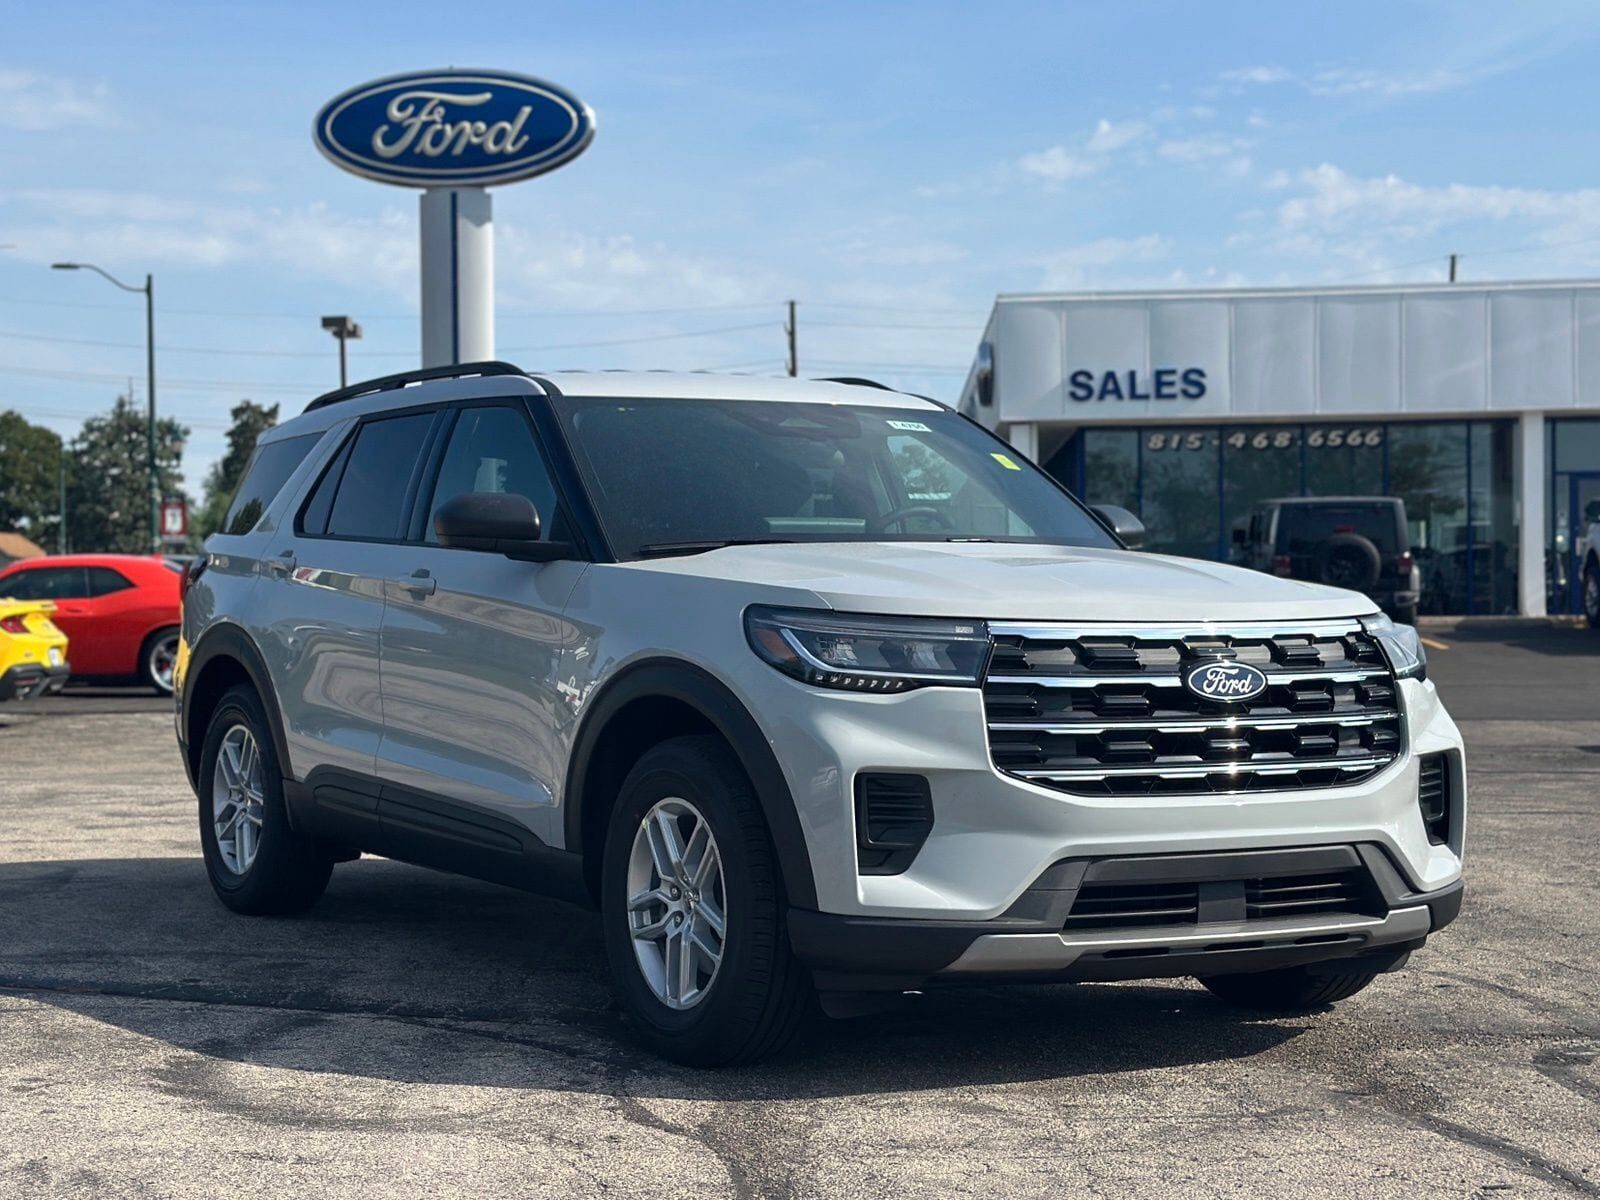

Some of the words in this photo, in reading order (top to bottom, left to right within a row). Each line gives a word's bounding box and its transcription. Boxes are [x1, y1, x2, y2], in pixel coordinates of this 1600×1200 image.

[372, 91, 533, 157] Ford
[1069, 368, 1207, 401] SALES
[1203, 667, 1253, 693] Ford
